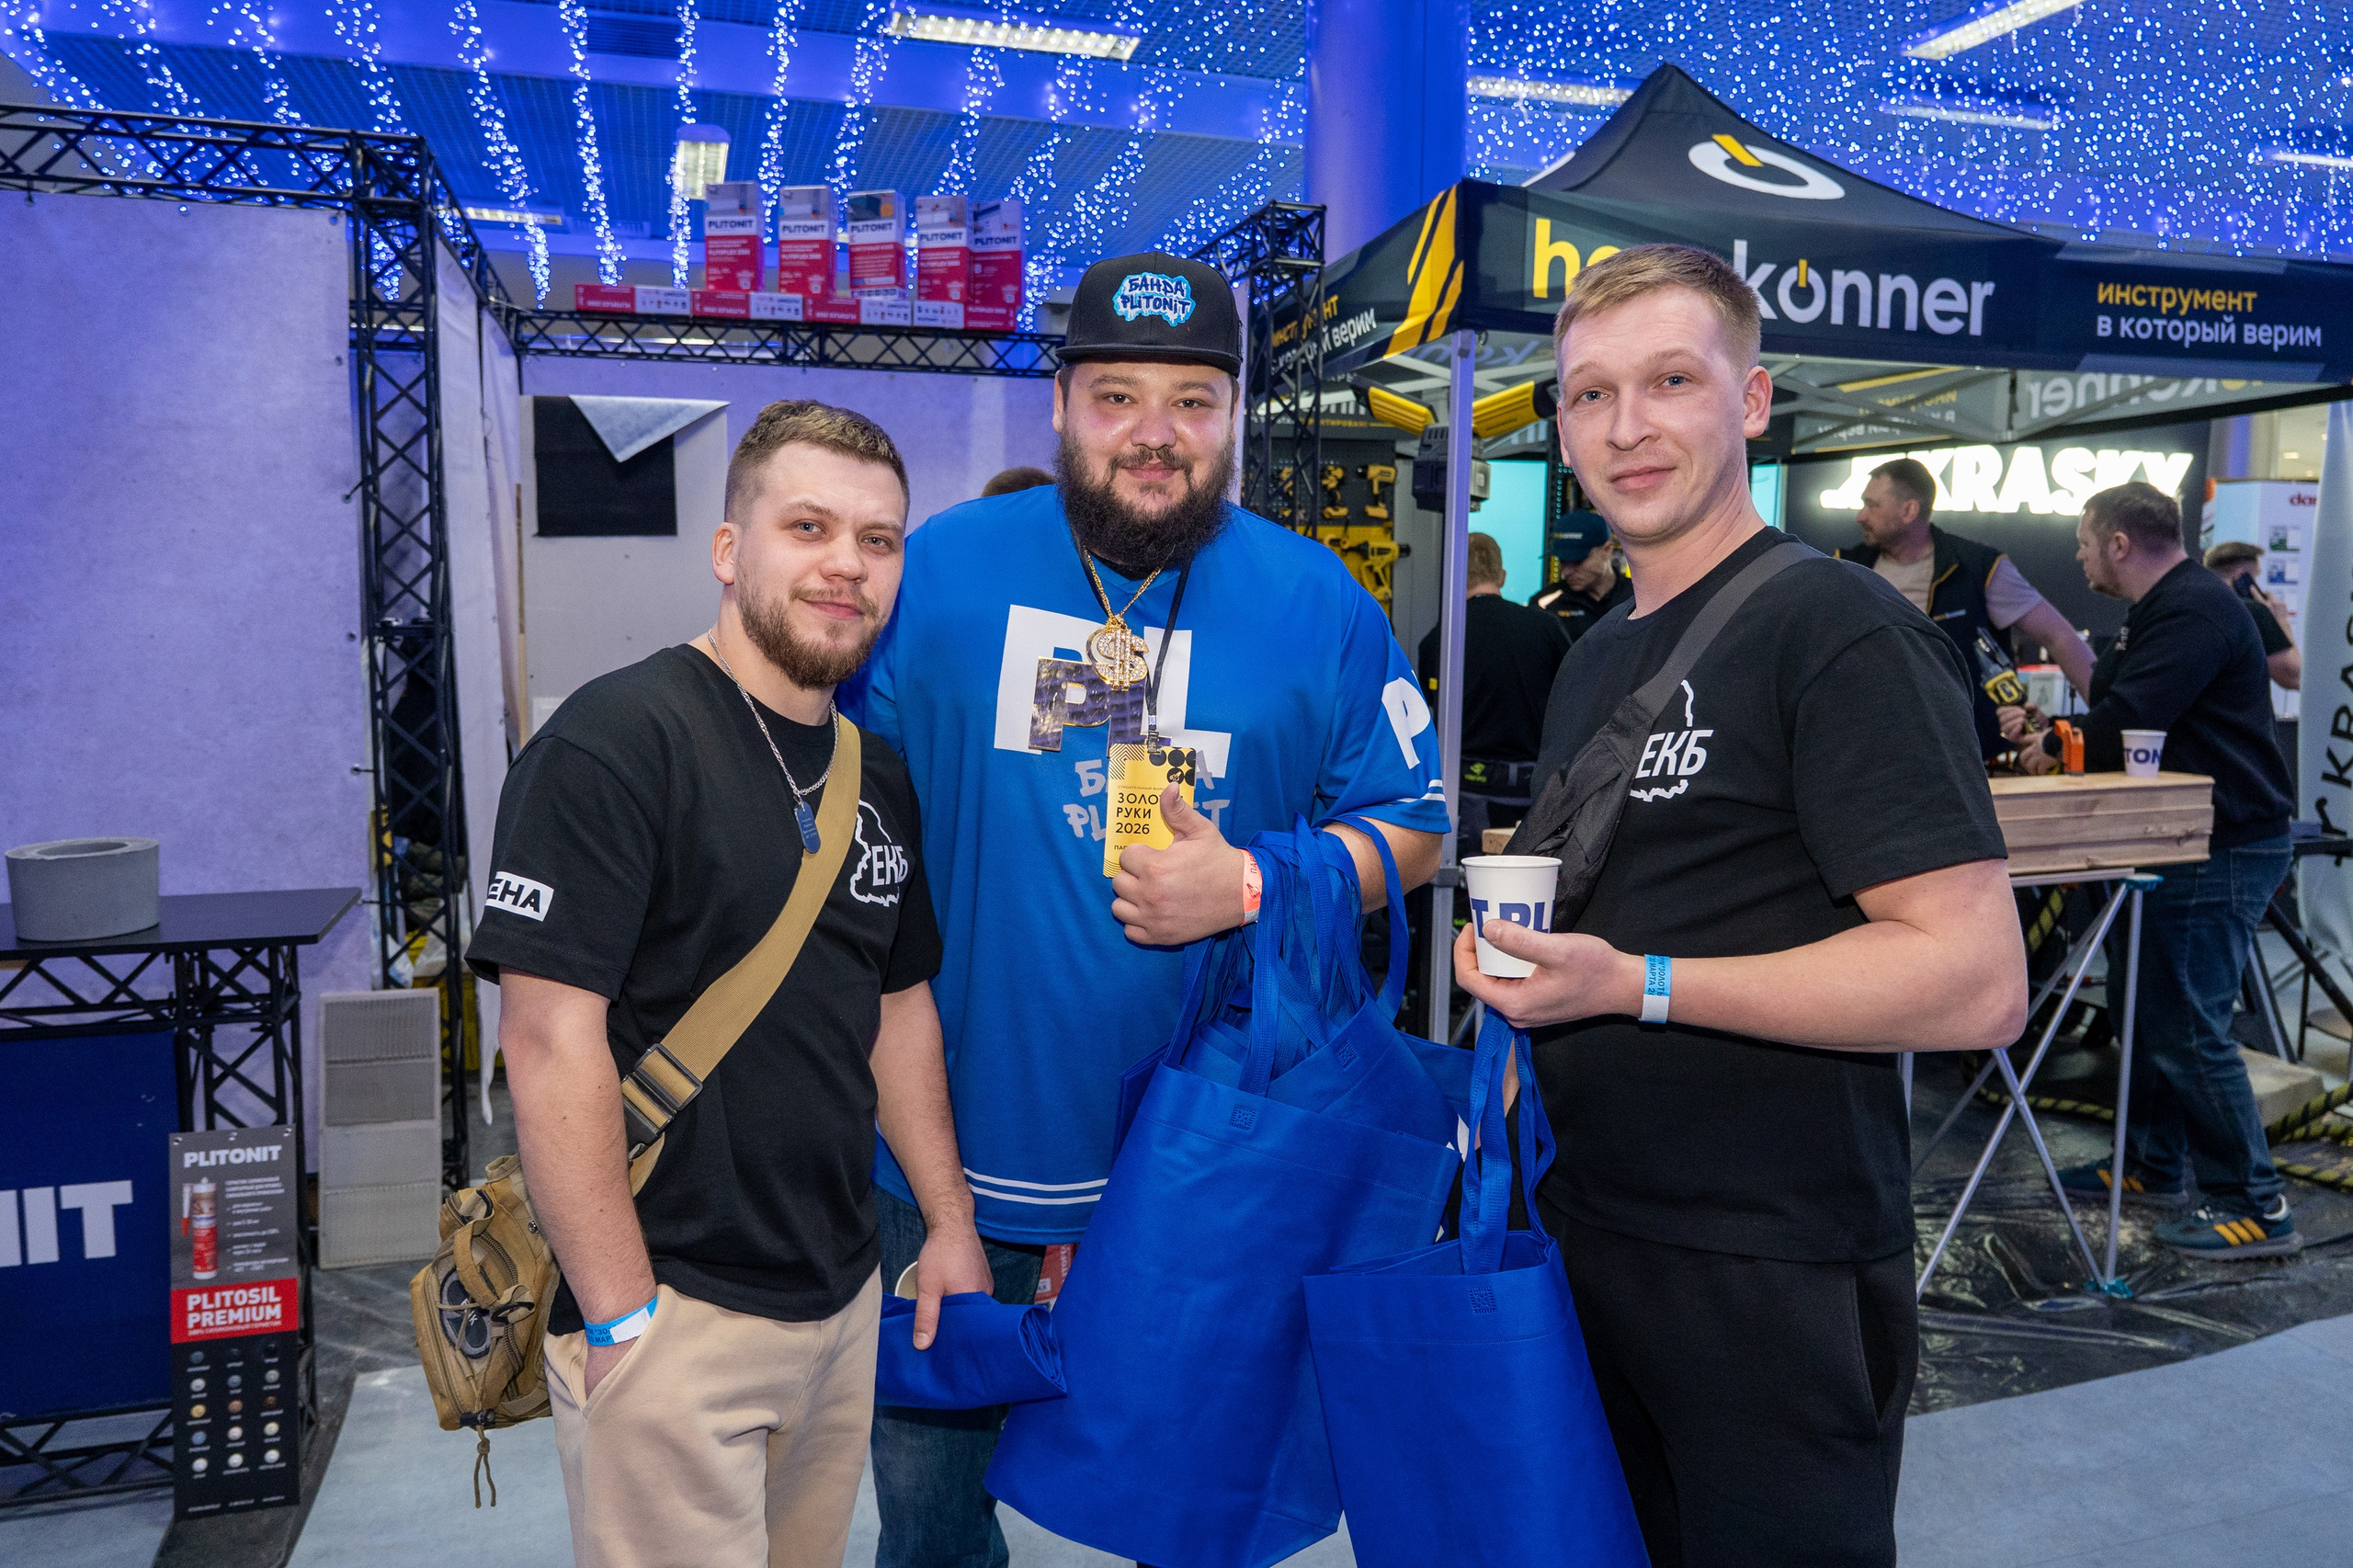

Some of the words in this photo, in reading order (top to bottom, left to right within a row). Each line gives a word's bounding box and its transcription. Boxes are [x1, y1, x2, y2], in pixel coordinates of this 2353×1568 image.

[1128, 275, 1186, 297] БАНДА
[2097, 281, 2258, 316] инструмент
[2097, 315, 2112, 337] в
[2120, 314, 2236, 348] который
[2243, 323, 2322, 353] верим
[1635, 729, 1714, 779] ЕКБ
[1118, 792, 1165, 805] ЗОЛО
[1116, 807, 1152, 819] РУКИ
[1115, 822, 1150, 835] 2026
[871, 845, 908, 887] ЕКБ
[184, 1144, 282, 1169] PLITONIT
[187, 1285, 281, 1312] PLITOSIL
[187, 1302, 281, 1329] PREMIUM
